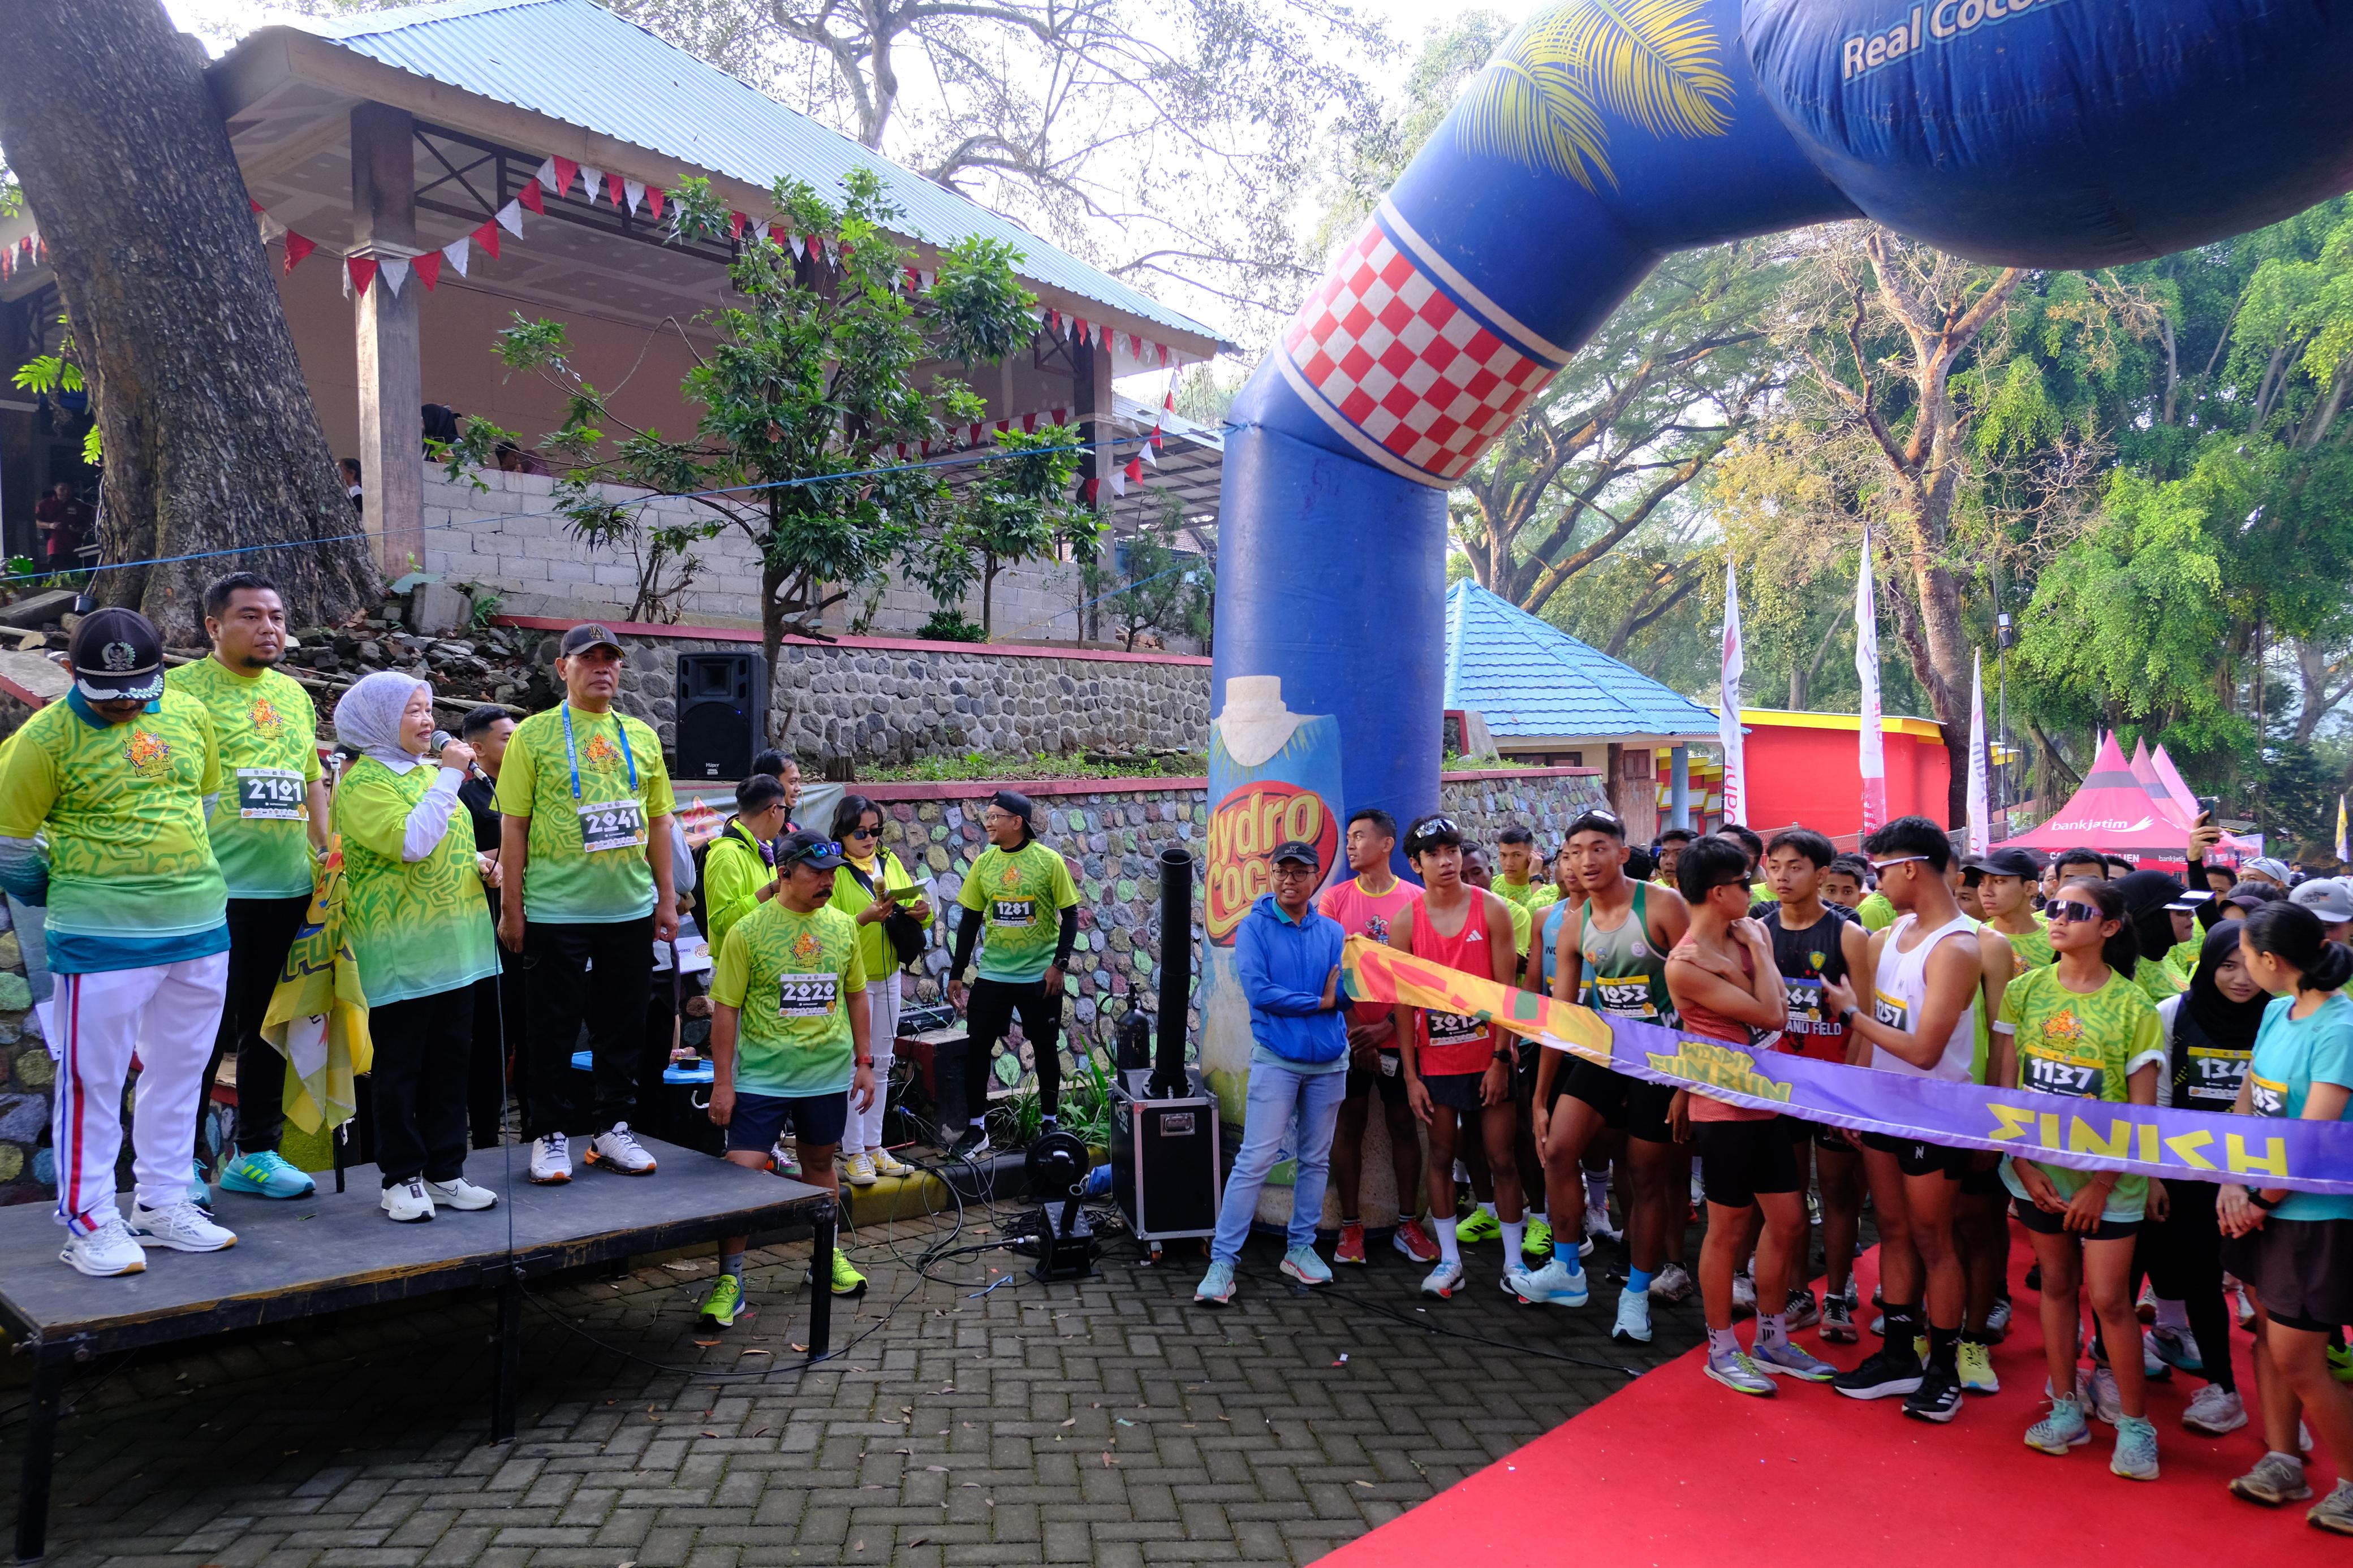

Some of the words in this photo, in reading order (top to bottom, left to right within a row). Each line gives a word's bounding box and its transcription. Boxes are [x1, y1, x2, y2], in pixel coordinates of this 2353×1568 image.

[1844, 6, 1921, 80] Real
[248, 778, 302, 801] 2101
[585, 808, 640, 834] 2041
[1205, 791, 1321, 866] Hydro
[2051, 818, 2128, 832] bankjatim
[997, 901, 1029, 915] 1281
[1206, 858, 1273, 936] Coc
[782, 982, 835, 1001] 2020
[1598, 984, 1649, 1004] 1053
[1785, 1020, 1809, 1034] AND
[1813, 1022, 1842, 1036] FIELD
[1649, 1055, 1709, 1086] FUN
[1716, 1063, 1791, 1103] RUN
[2031, 1058, 2094, 1090] 1137
[2196, 1057, 2249, 1079] 134
[1986, 1103, 2289, 1177] FINISH
